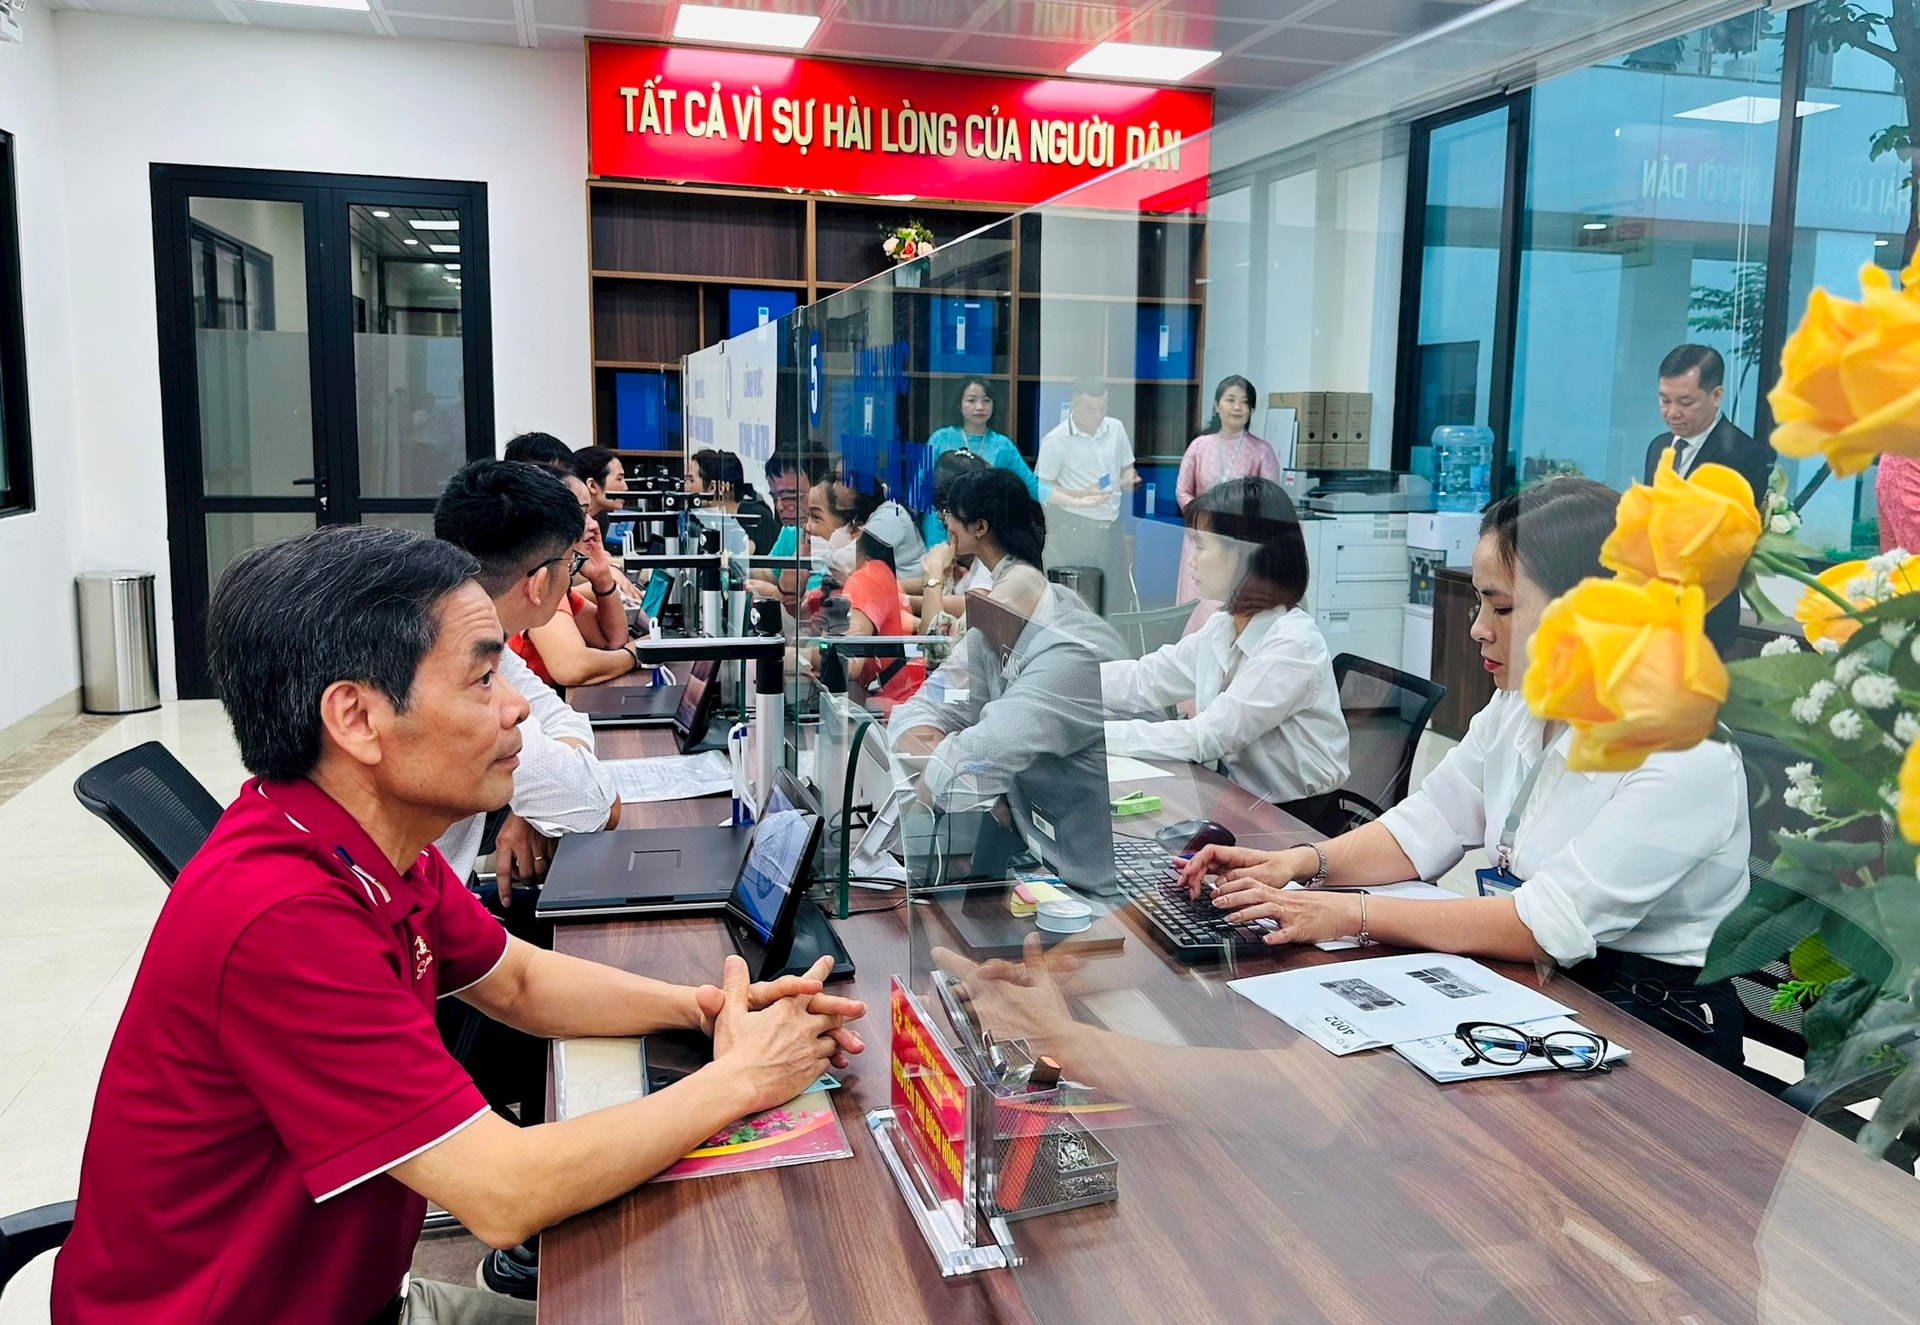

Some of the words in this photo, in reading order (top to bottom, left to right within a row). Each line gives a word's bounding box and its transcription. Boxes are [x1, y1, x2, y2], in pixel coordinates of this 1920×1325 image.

[619, 77, 674, 135] TẤT
[684, 80, 728, 140] CẢ
[732, 86, 763, 142] VÌ
[771, 101, 814, 157] SỰ
[822, 95, 872, 151] HÀI
[881, 99, 957, 157] LÒNG
[964, 104, 1019, 162] CỦA
[1029, 114, 1115, 168] NGƯỜI
[1125, 121, 1182, 173] DÂN
[809, 343, 819, 415] 5
[1324, 1015, 1355, 1036] 4002
